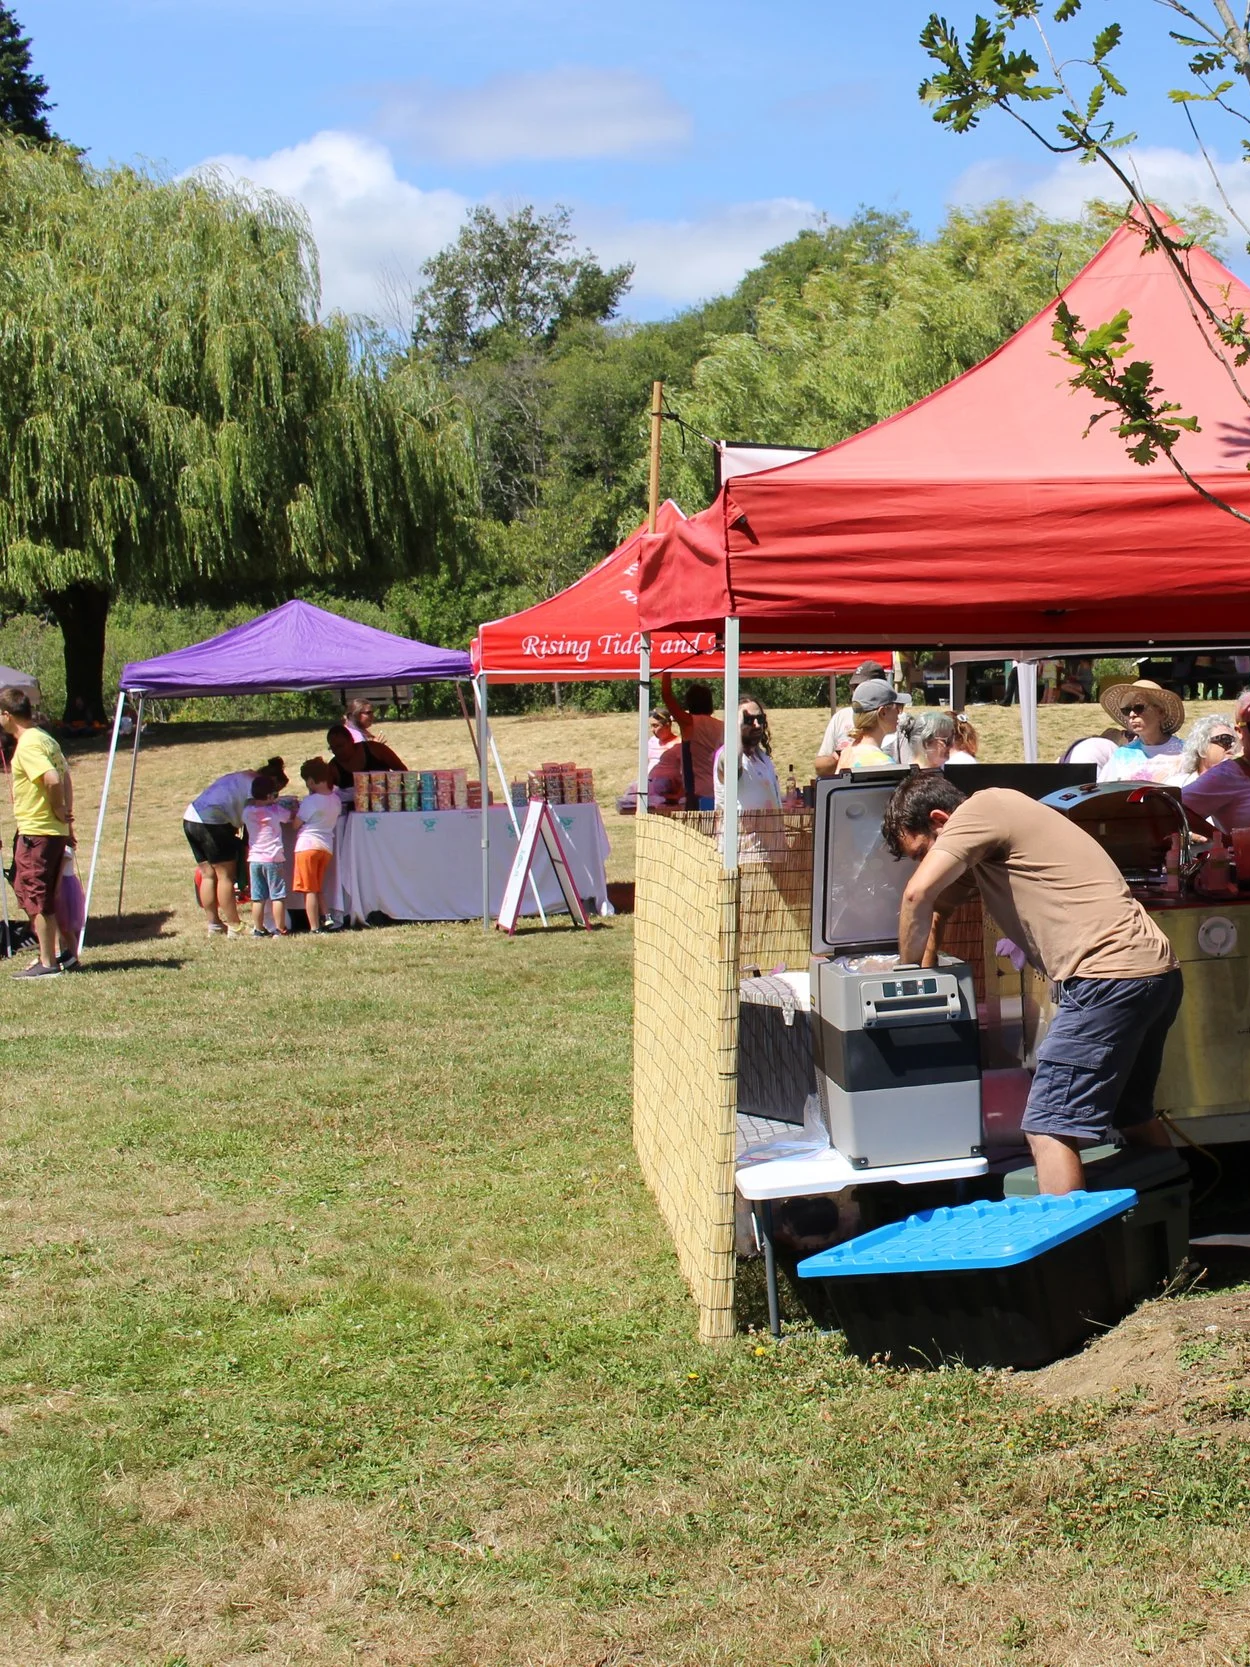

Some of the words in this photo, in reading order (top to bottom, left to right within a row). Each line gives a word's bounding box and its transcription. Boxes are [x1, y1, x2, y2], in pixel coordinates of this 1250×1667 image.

[521, 634, 591, 662] Rising
[598, 632, 653, 656] Tide
[660, 632, 705, 654] and
